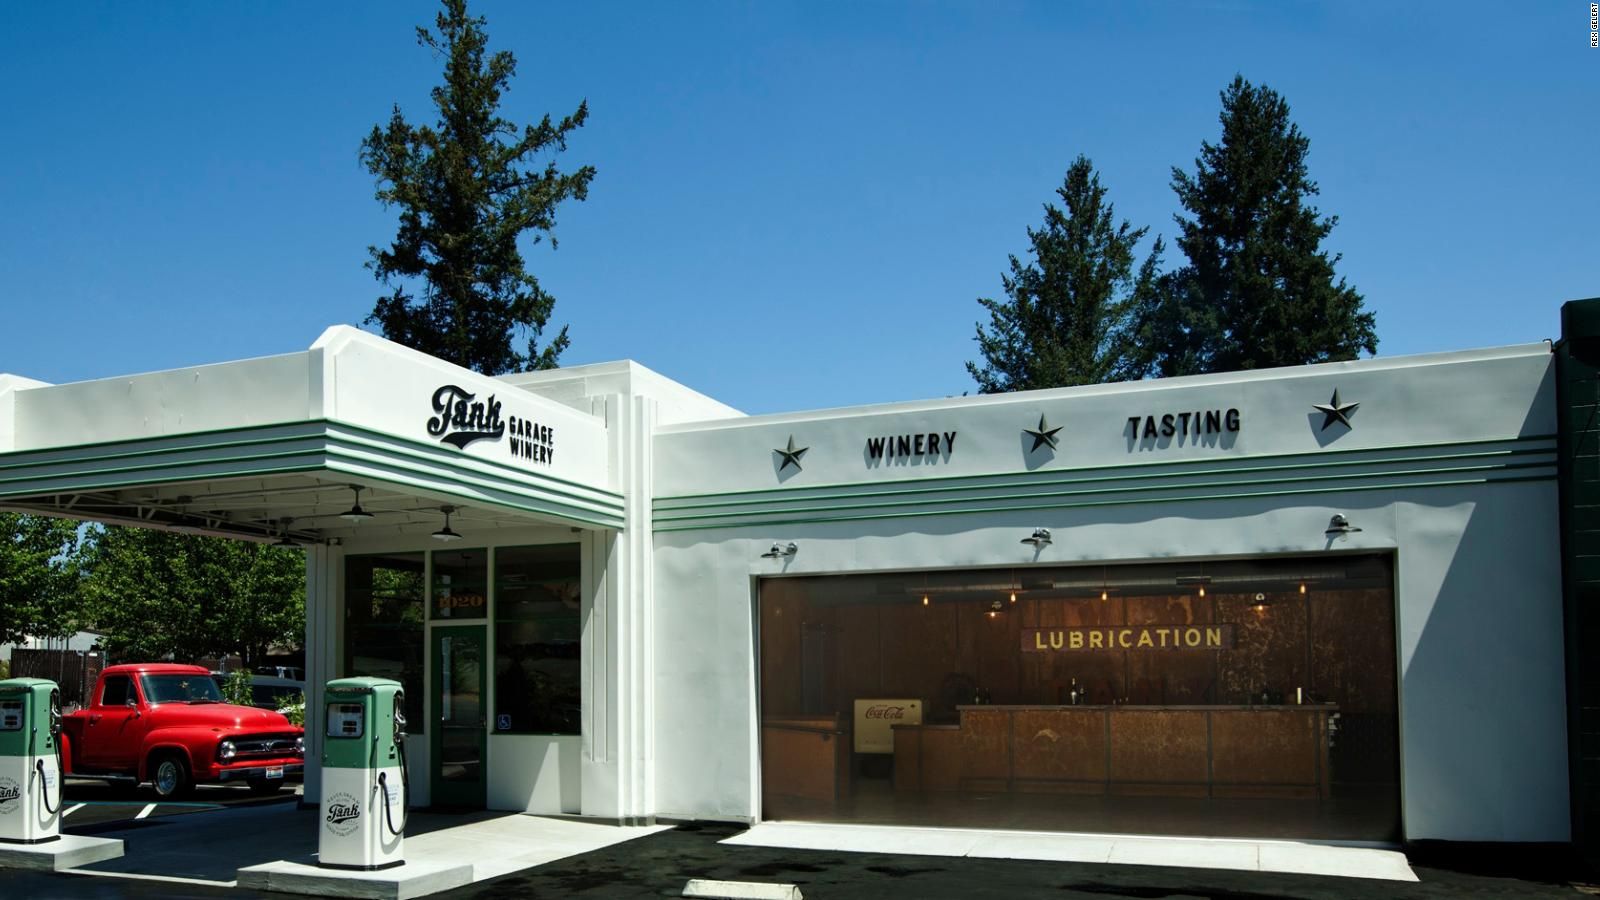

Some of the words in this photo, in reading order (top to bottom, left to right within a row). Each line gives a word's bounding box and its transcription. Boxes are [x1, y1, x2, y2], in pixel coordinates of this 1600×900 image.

[427, 384, 505, 450] Tank
[509, 416, 553, 445] GARAGE
[1128, 408, 1240, 440] TASTING
[509, 436, 554, 465] WINERY
[867, 431, 957, 459] WINERY
[1035, 628, 1222, 649] LUBRICATION
[326, 803, 360, 824] Tank
